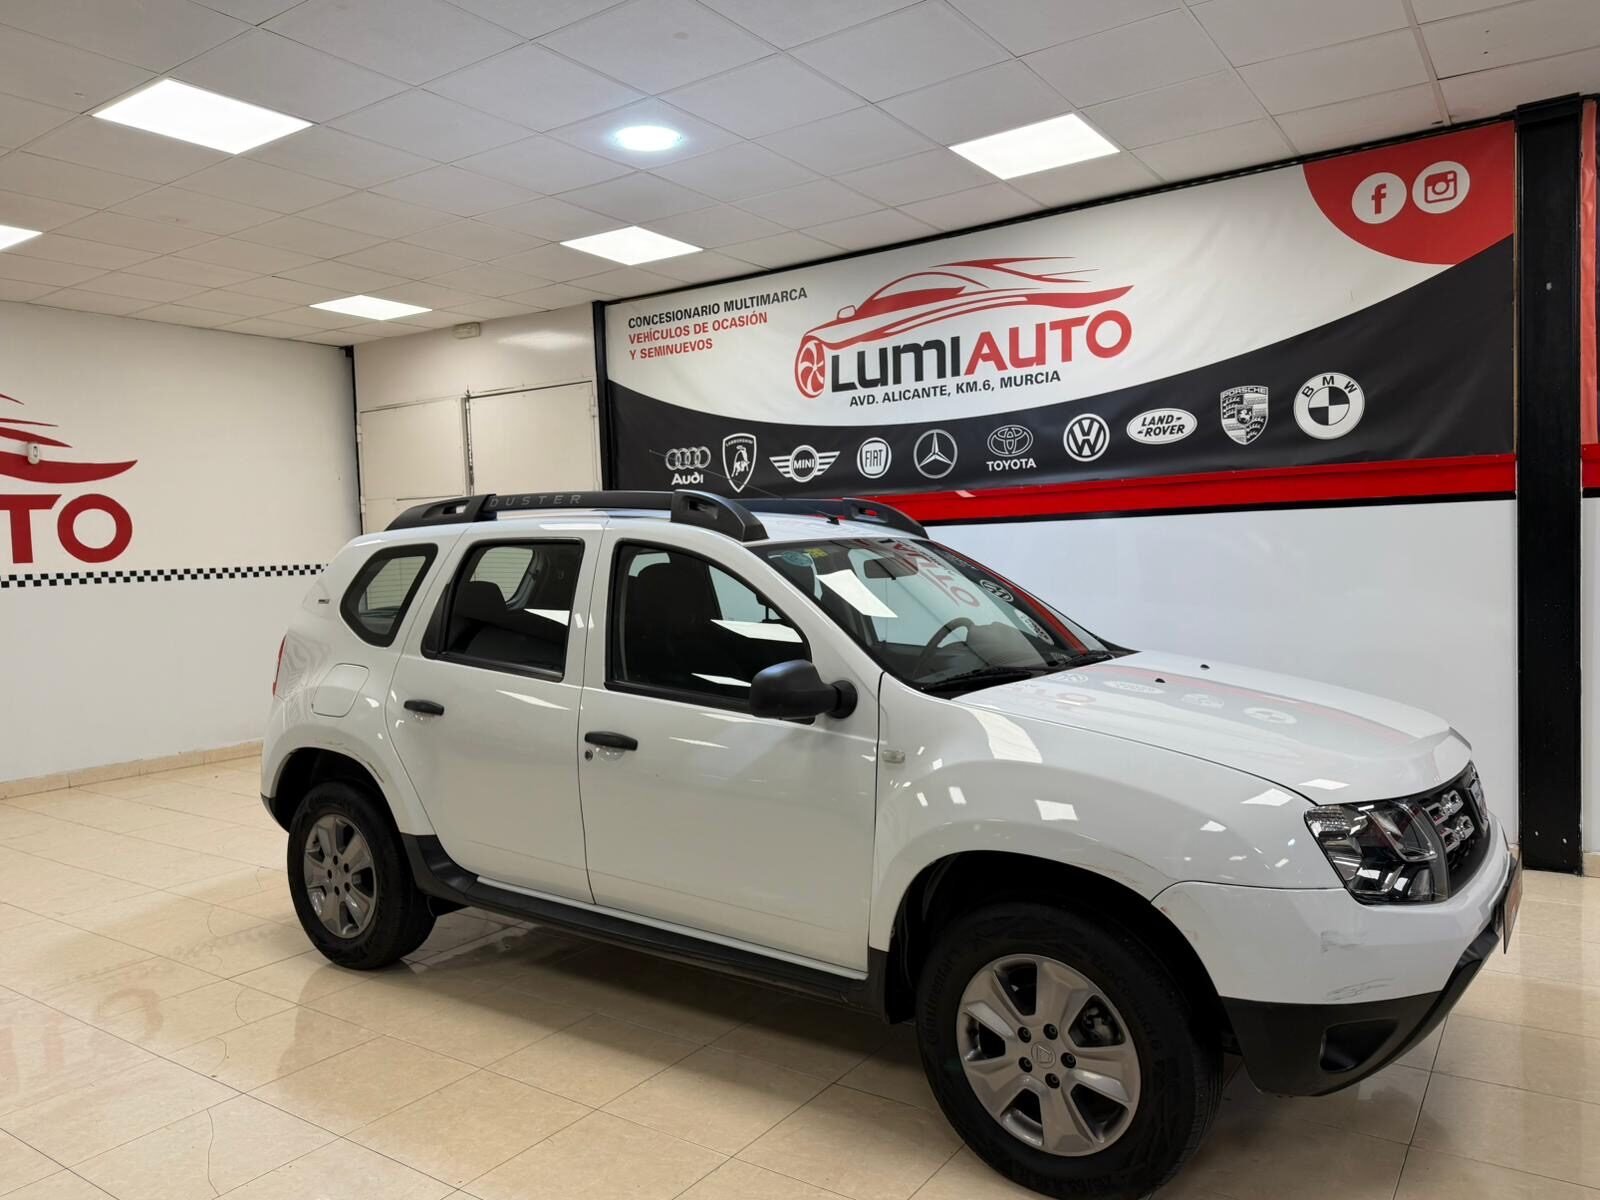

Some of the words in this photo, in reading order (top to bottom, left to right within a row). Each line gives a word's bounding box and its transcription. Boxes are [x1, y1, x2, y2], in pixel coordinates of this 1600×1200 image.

[628, 303, 720, 329] CONCESIONARIO
[724, 287, 808, 313] MULTIMARCA
[629, 325, 690, 345] VEHÍCULOS
[693, 322, 709, 335] DE
[712, 311, 768, 331] OCASIÓN
[629, 350, 637, 360] Y
[640, 338, 713, 359] SEMINUEVOS
[849, 391, 879, 407] AVD.
[882, 384, 951, 404] ALICANTE,
[955, 379, 995, 396] KM.6,
[999, 370, 1061, 389] MURCIA
[793, 458, 815, 470] MINI
[865, 449, 884, 468] FIAT
[986, 458, 1037, 471] TOYOTA
[671, 472, 704, 486] Audi
[488, 494, 582, 508] DUSTER
